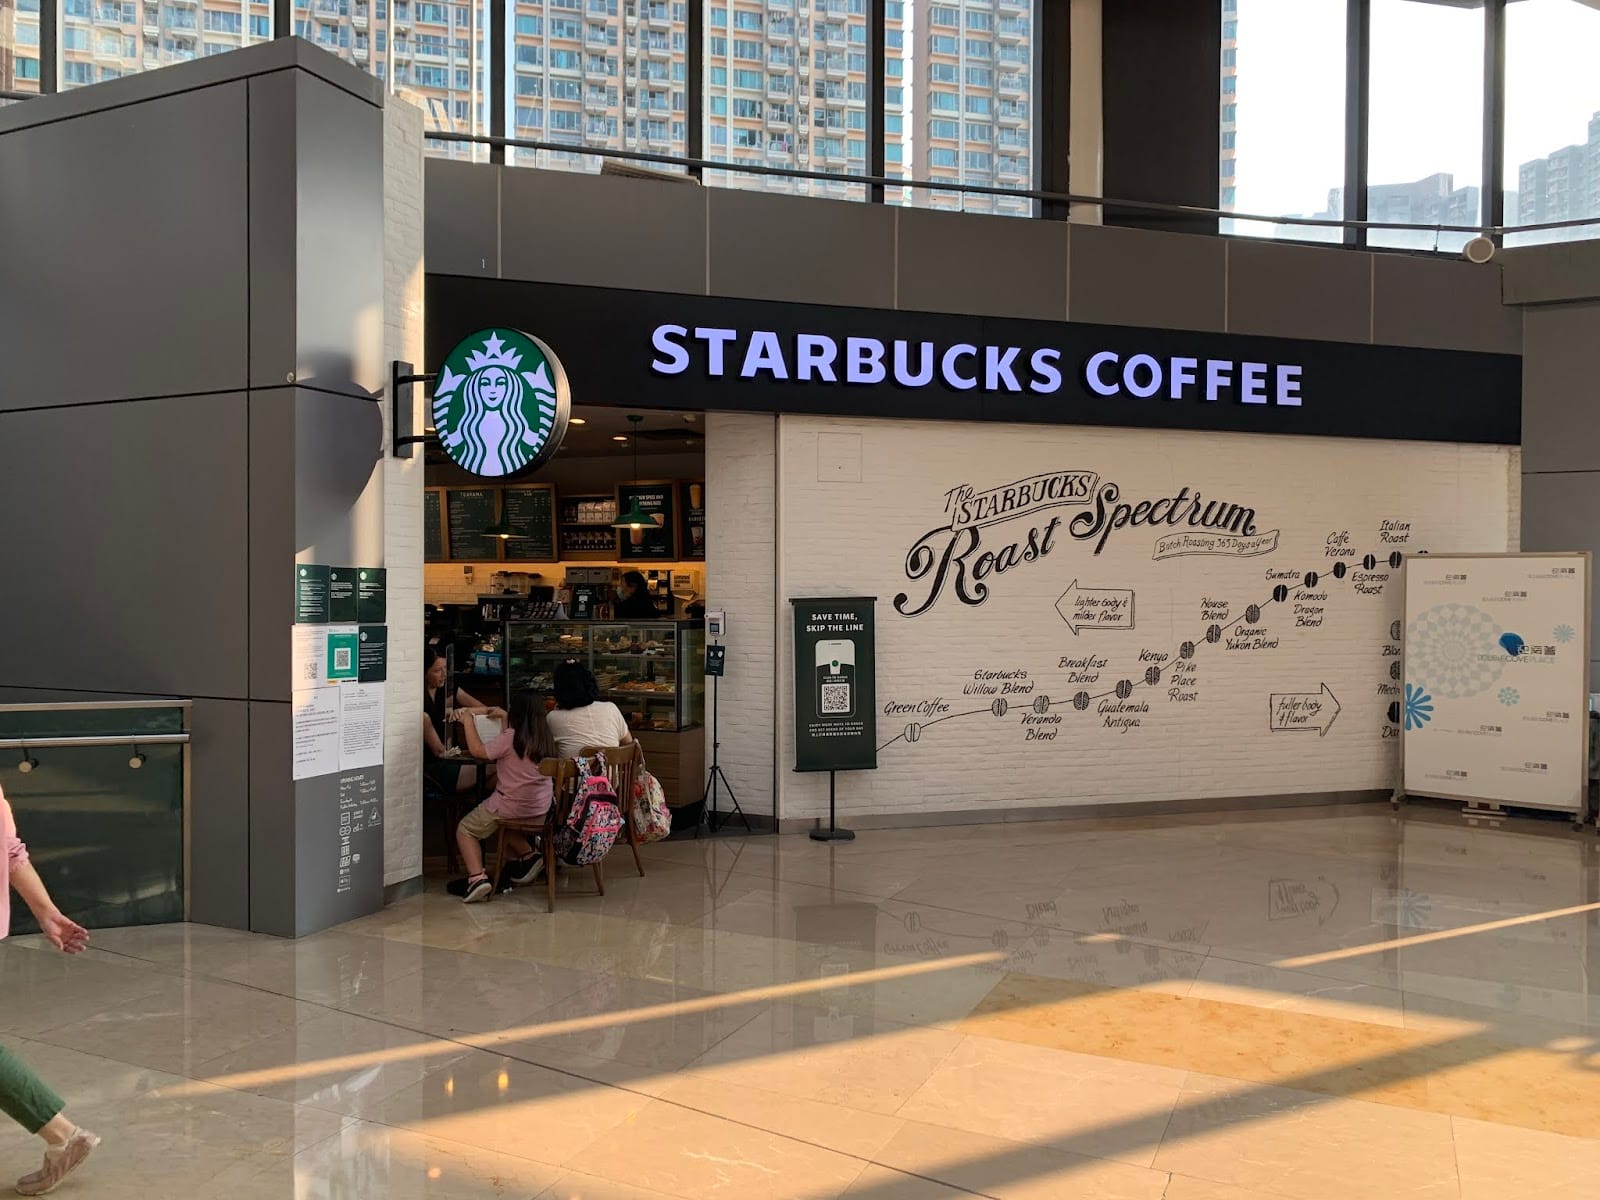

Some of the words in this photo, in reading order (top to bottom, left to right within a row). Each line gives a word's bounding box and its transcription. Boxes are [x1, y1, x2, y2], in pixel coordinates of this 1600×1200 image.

[651, 324, 1062, 393] STARBUCKS
[1086, 351, 1303, 406] COFFEE
[944, 484, 976, 513] The
[957, 474, 1092, 526] STARBUCKS
[1379, 519, 1411, 532] Italian
[1159, 537, 1182, 553] Batch
[1183, 535, 1216, 550] Roasting
[1380, 532, 1410, 544] Roast
[893, 516, 1062, 618] Roast
[1069, 482, 1257, 557] Spectrum
[1324, 546, 1356, 557] Verona
[1265, 568, 1301, 581] Sumatra
[1351, 571, 1390, 583] Espresso
[1293, 590, 1328, 601] Komodo
[1354, 583, 1384, 595] Roast
[1074, 595, 1101, 610] lighter
[1101, 596, 1121, 612] body
[1201, 597, 1229, 609] House
[811, 613, 833, 621] SAVE
[834, 612, 858, 621] TIME,
[1072, 609, 1097, 621] milder
[1097, 610, 1123, 624] flavor
[1201, 609, 1229, 621] Blend
[1293, 604, 1324, 617] Dragon
[806, 624, 826, 632] SKIP
[827, 624, 843, 632] THE
[845, 623, 864, 631] LINE
[1295, 615, 1324, 627] Blend
[1234, 626, 1267, 639] Organic
[1225, 638, 1251, 651] Yukon
[1252, 637, 1280, 649] Blend
[1058, 654, 1109, 672] Breakfast
[1138, 648, 1169, 665] Kenya
[1174, 661, 1197, 673] Pike
[974, 668, 1028, 680] Starbucks
[1067, 672, 1099, 683] Blend
[1170, 674, 1197, 686] Place
[963, 682, 998, 695] Willow
[1000, 680, 1035, 695] Blend
[1167, 687, 1199, 702] Roast
[884, 700, 915, 716] Green
[916, 697, 951, 718] Coffee
[1097, 700, 1150, 717] Guatemala
[1276, 696, 1302, 715] fuller
[1302, 697, 1323, 717] body
[1021, 712, 1063, 725] Veranda
[1284, 711, 1309, 727] flavor
[1102, 717, 1141, 735] Antigua
[1025, 727, 1058, 741] Blend
